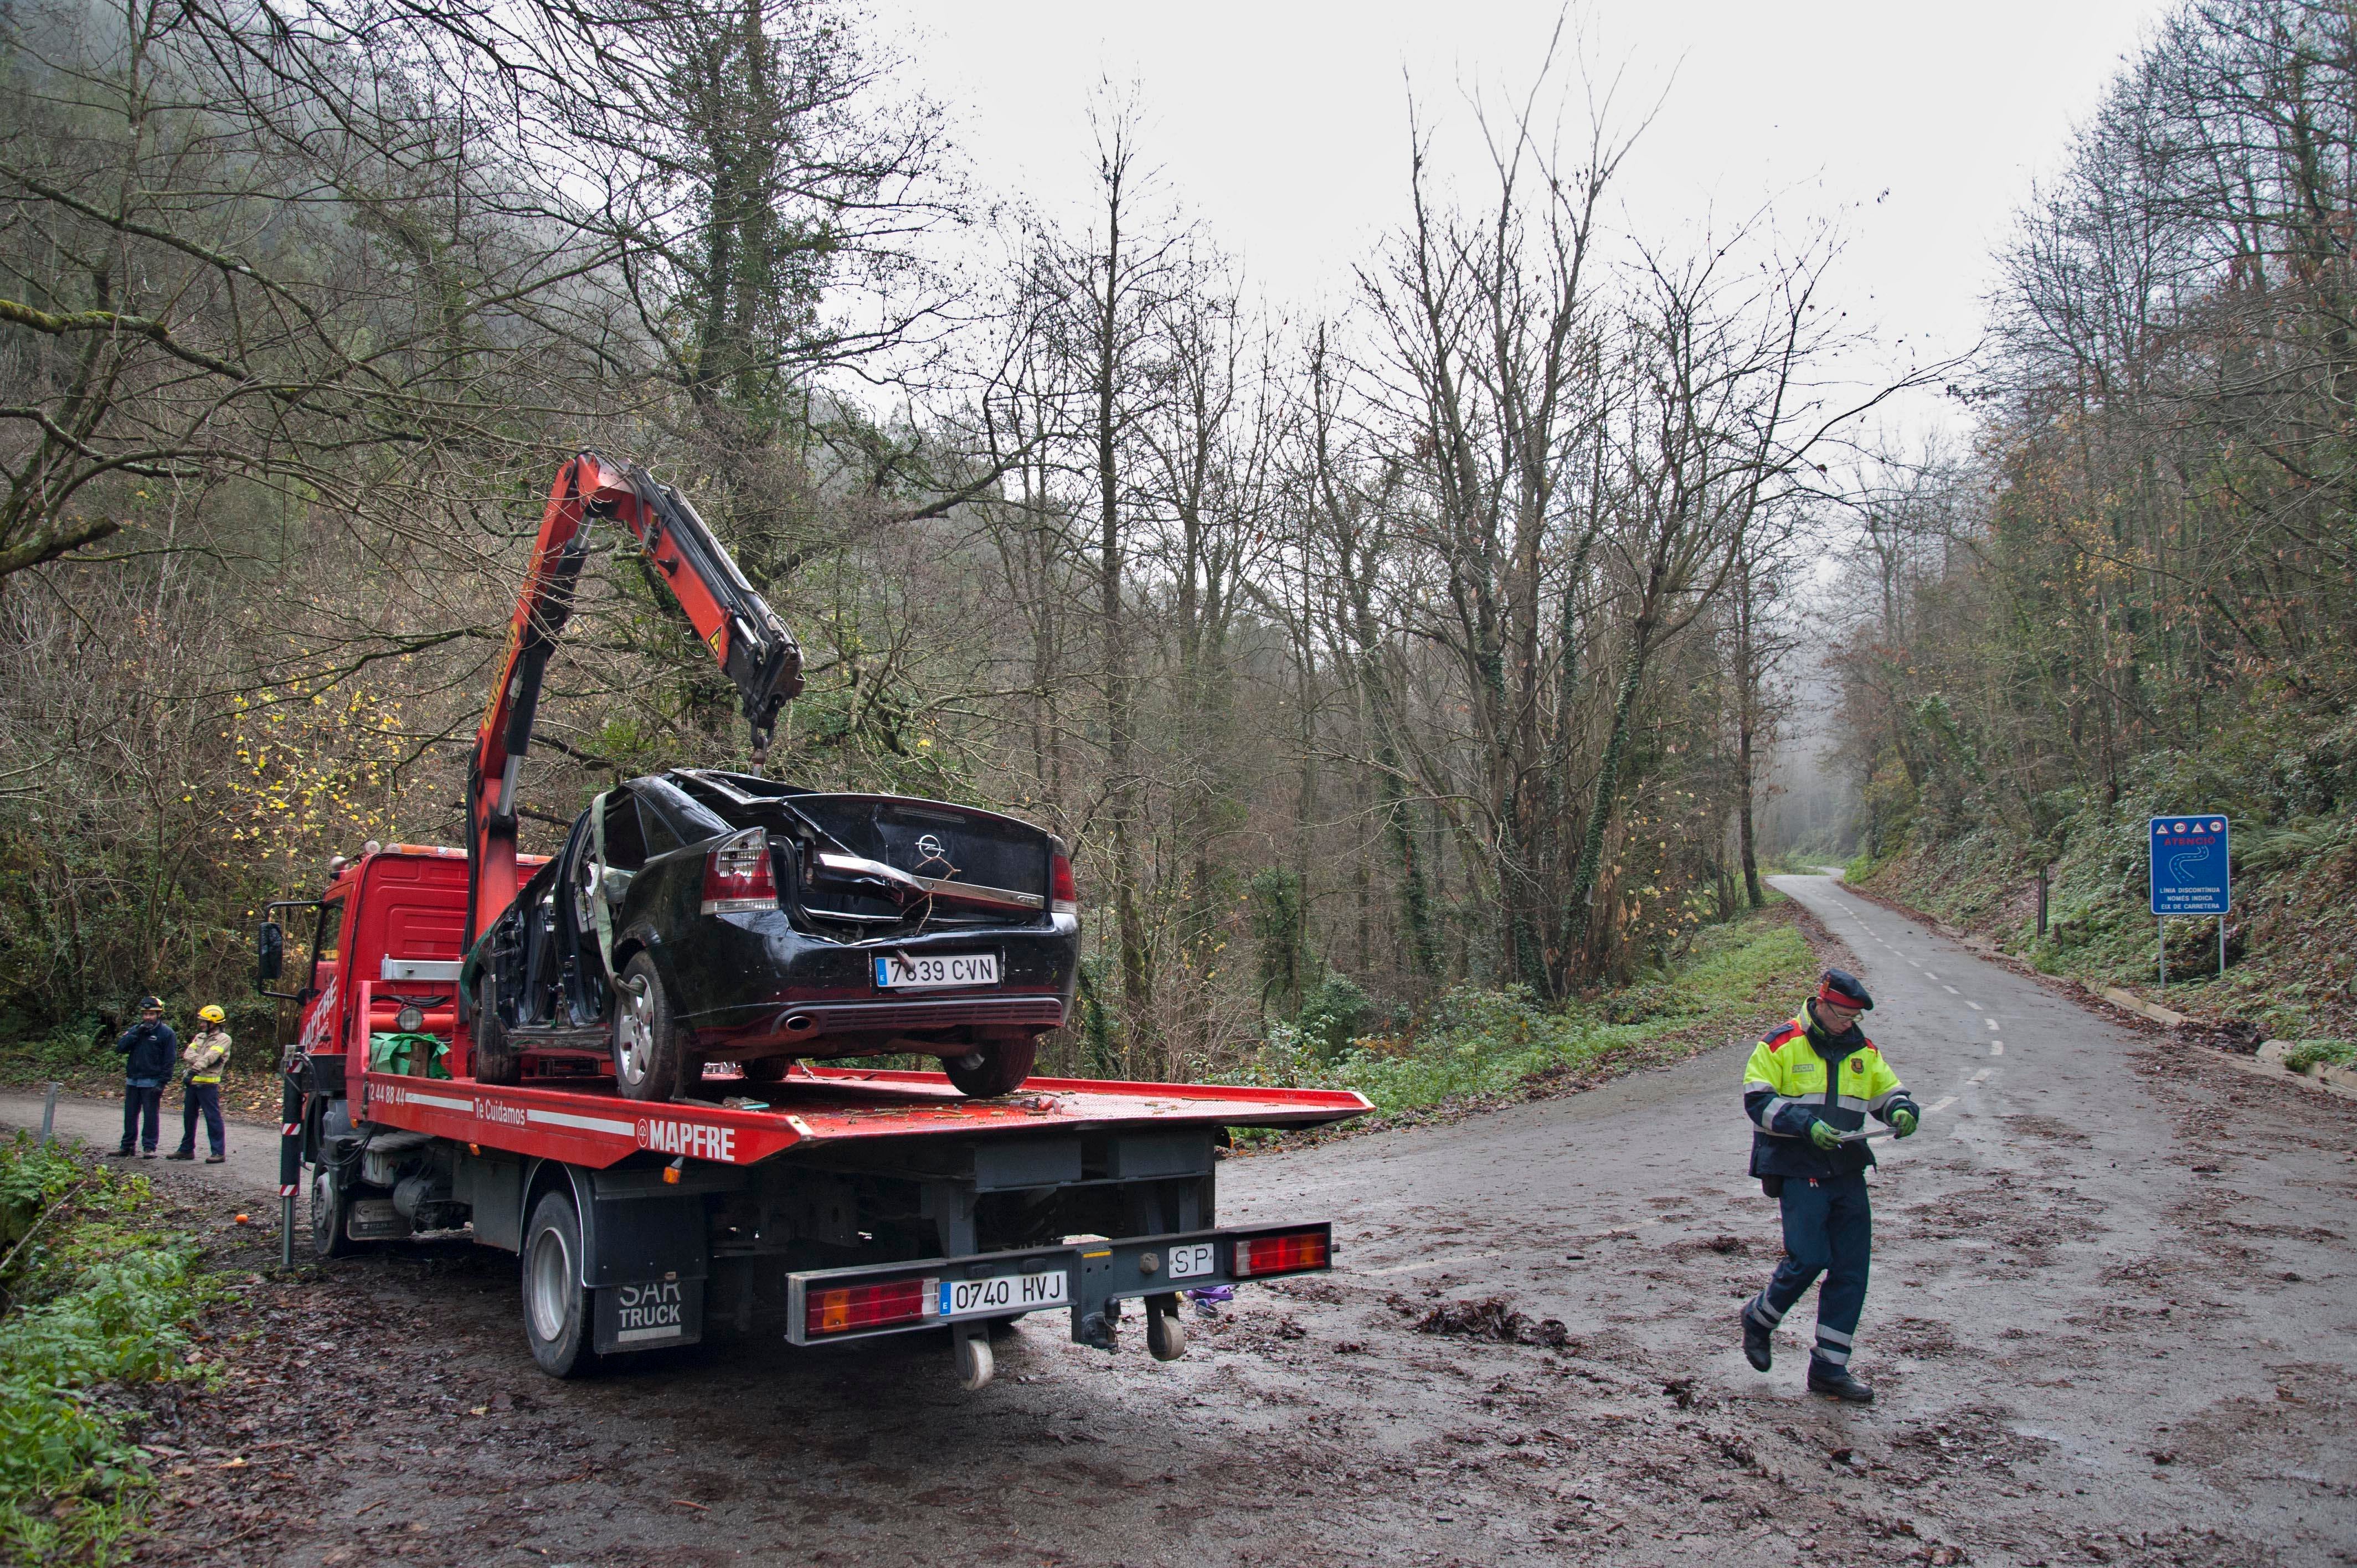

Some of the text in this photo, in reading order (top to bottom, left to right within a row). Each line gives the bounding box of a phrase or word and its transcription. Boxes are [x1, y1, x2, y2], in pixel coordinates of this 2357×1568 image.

[486, 629, 516, 725] PALFINGER
[2164, 835, 2216, 846] ATENCIÓ
[952, 959, 992, 980] CVN
[376, 1084, 384, 1102] 44
[386, 1086, 395, 1104] 88
[396, 1087, 405, 1106] 44
[475, 1097, 526, 1126] Te Cuidamos
[650, 1120, 735, 1162] MAPFRE
[1175, 1248, 1208, 1273] SP
[956, 1275, 1060, 1309] 0740 HVJ
[619, 1304, 681, 1328] TRUCK
